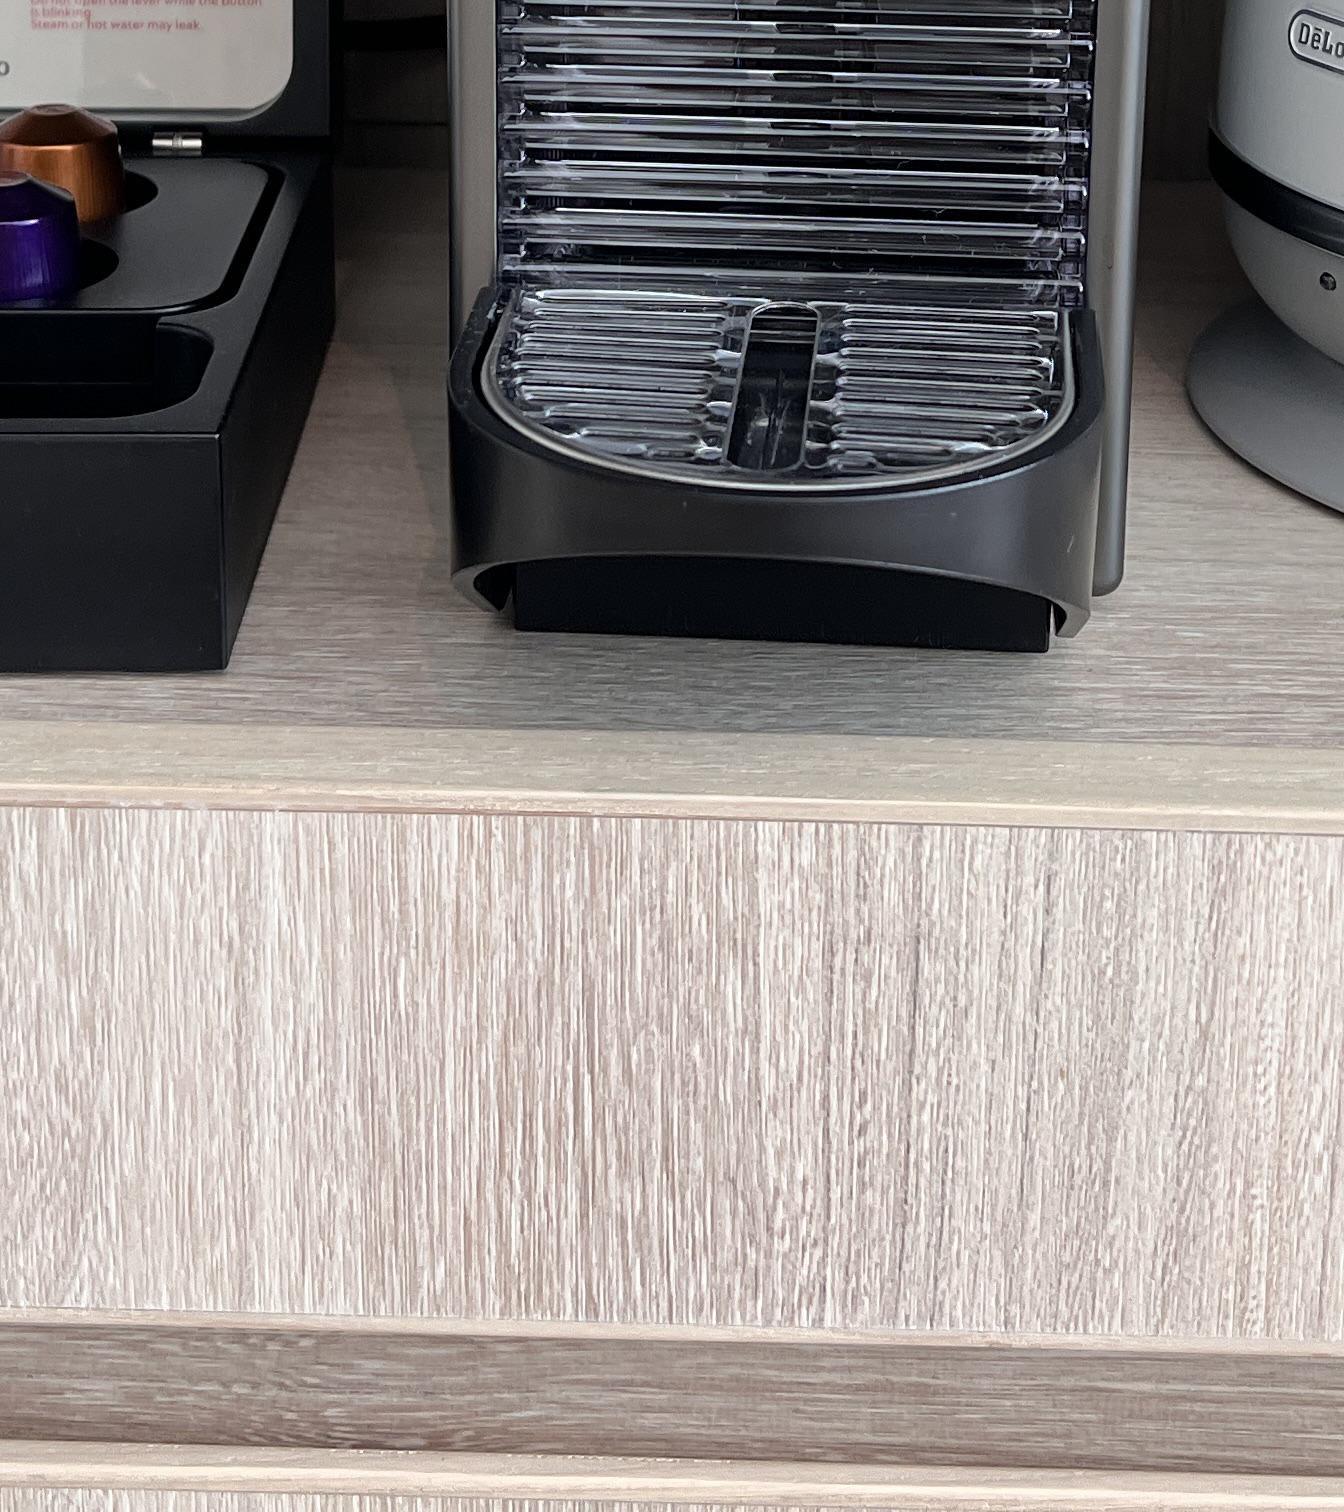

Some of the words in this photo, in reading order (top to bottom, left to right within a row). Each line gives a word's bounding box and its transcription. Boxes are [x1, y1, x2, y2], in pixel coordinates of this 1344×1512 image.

[31, 19, 68, 29] Steam
[87, 19, 106, 29] hot
[111, 20, 144, 29] water
[147, 21, 172, 32] may
